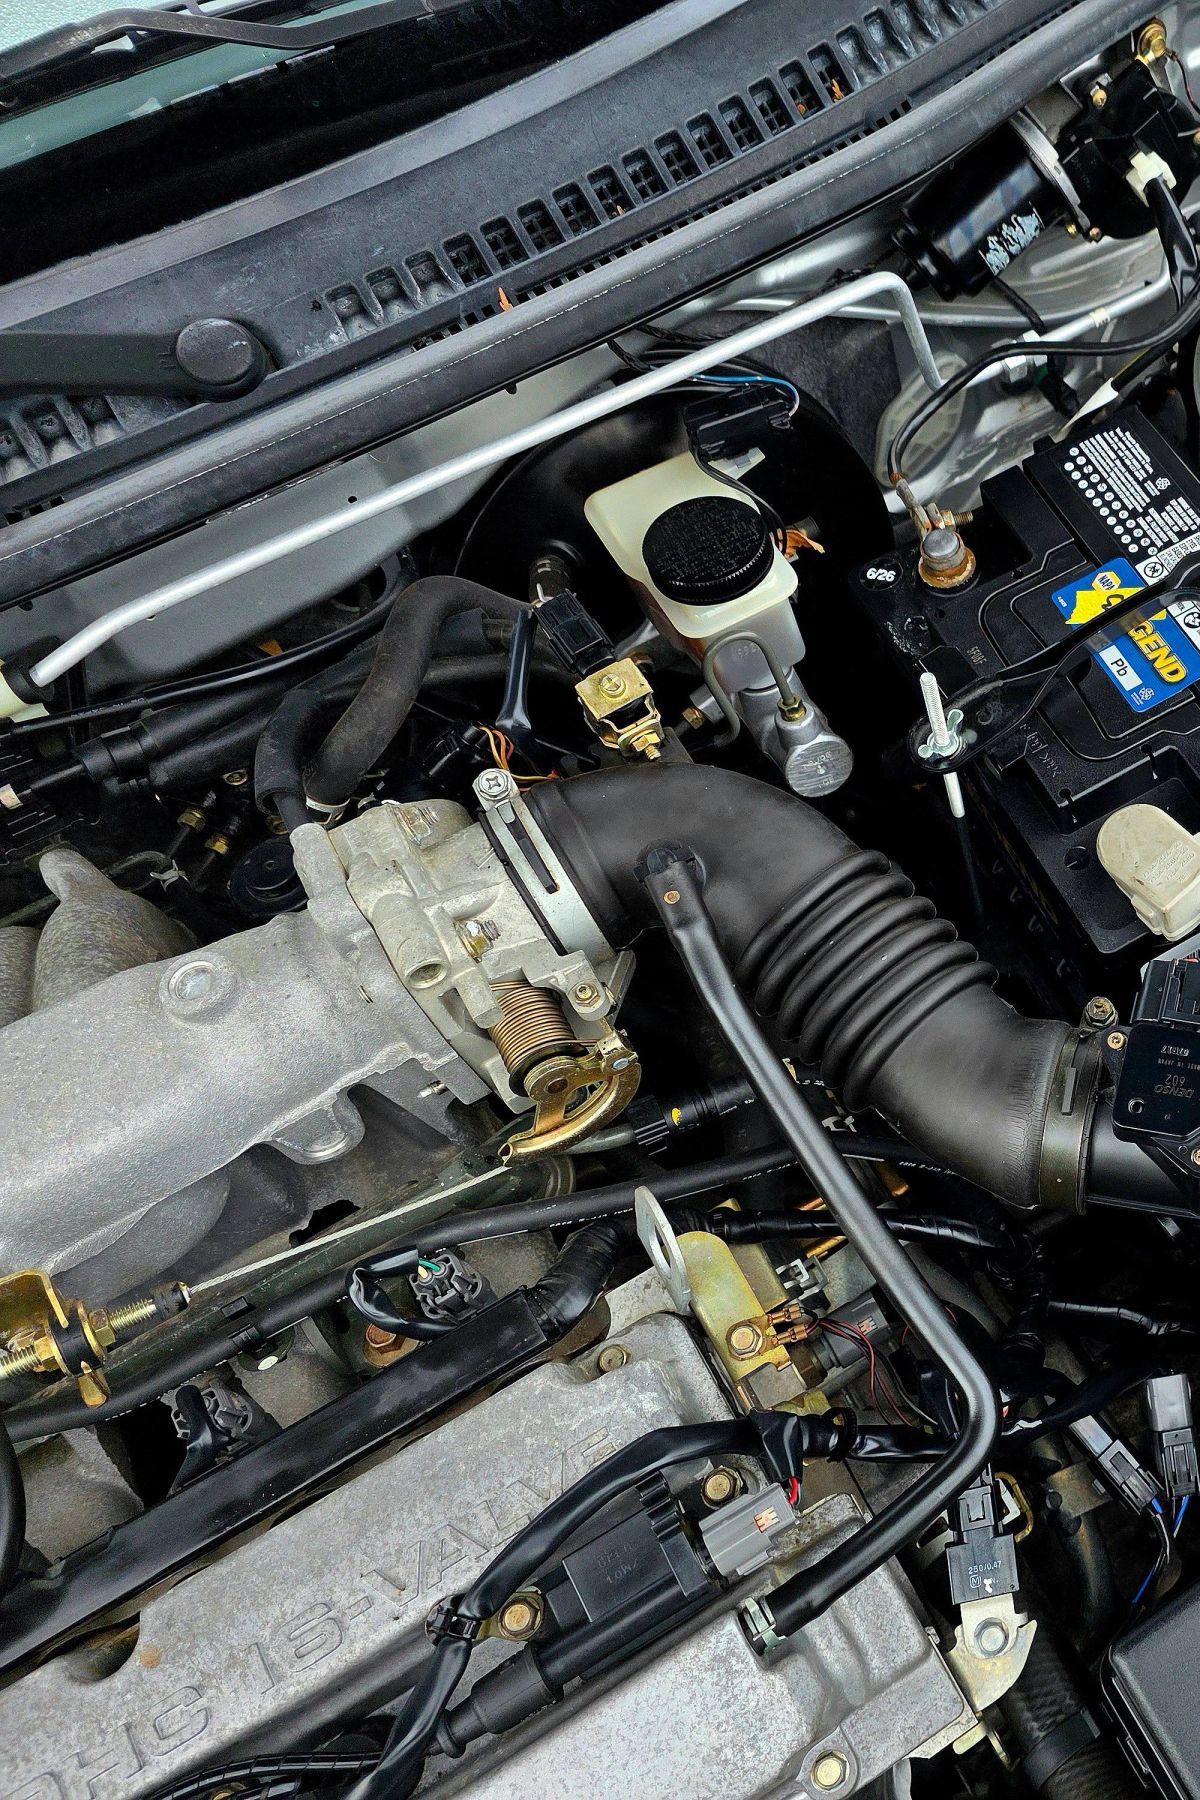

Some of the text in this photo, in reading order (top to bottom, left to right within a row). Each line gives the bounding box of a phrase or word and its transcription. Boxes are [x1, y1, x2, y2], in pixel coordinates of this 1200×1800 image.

[866, 567, 896, 582] 6/26
[1097, 573, 1117, 592] NAPA
[1126, 619, 1189, 686] GEND
[1110, 656, 1131, 678] Pb
[1164, 1073, 1185, 1086] 602
[1153, 1083, 1194, 1098] DENSO
[968, 1560, 1001, 1574] 250/0.47
